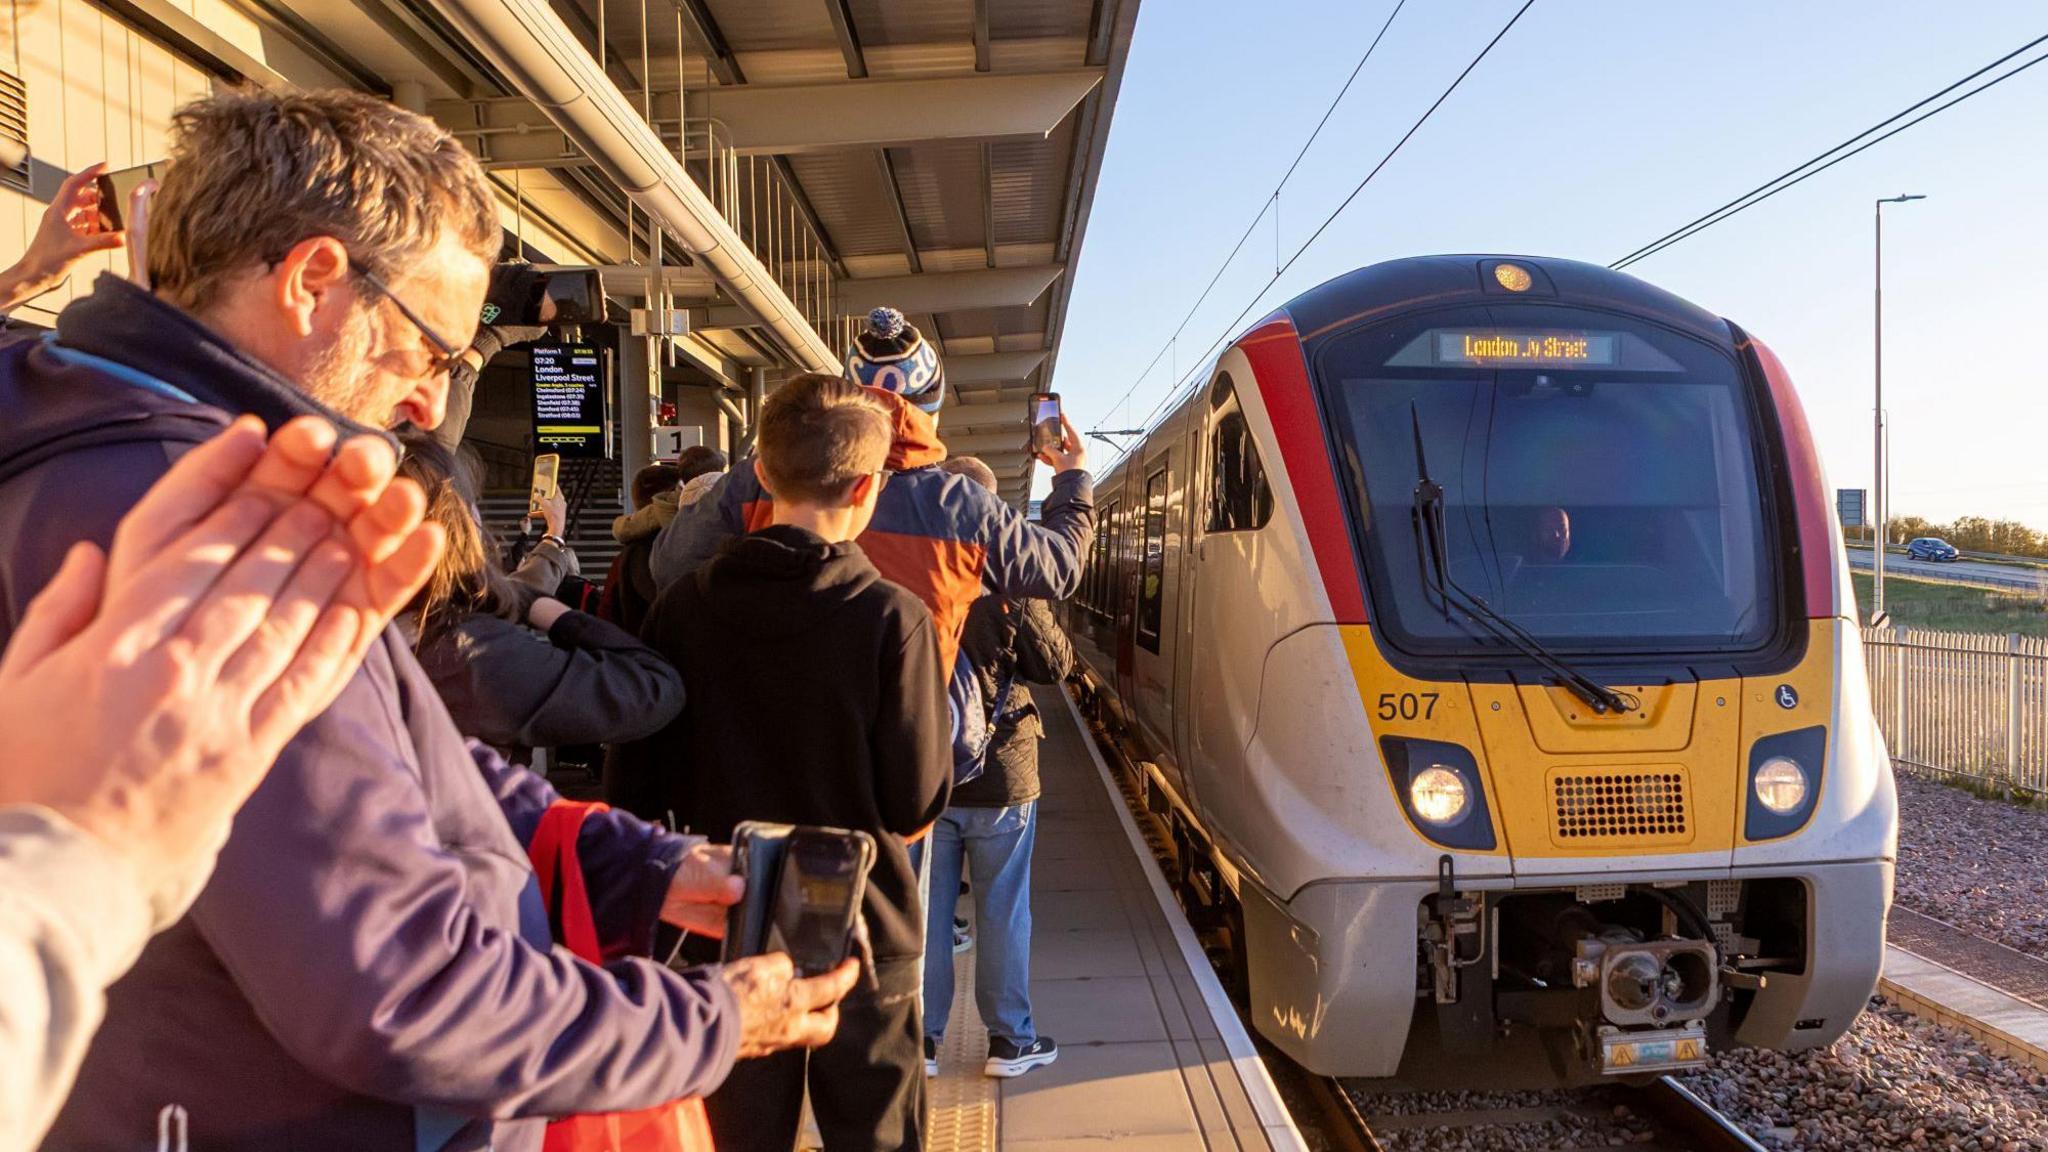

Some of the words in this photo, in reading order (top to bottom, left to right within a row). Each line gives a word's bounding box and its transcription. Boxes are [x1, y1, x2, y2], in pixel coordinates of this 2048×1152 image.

[535, 374, 570, 382] Liverpool
[670, 431, 681, 454] 1
[1378, 693, 1440, 720] 507
